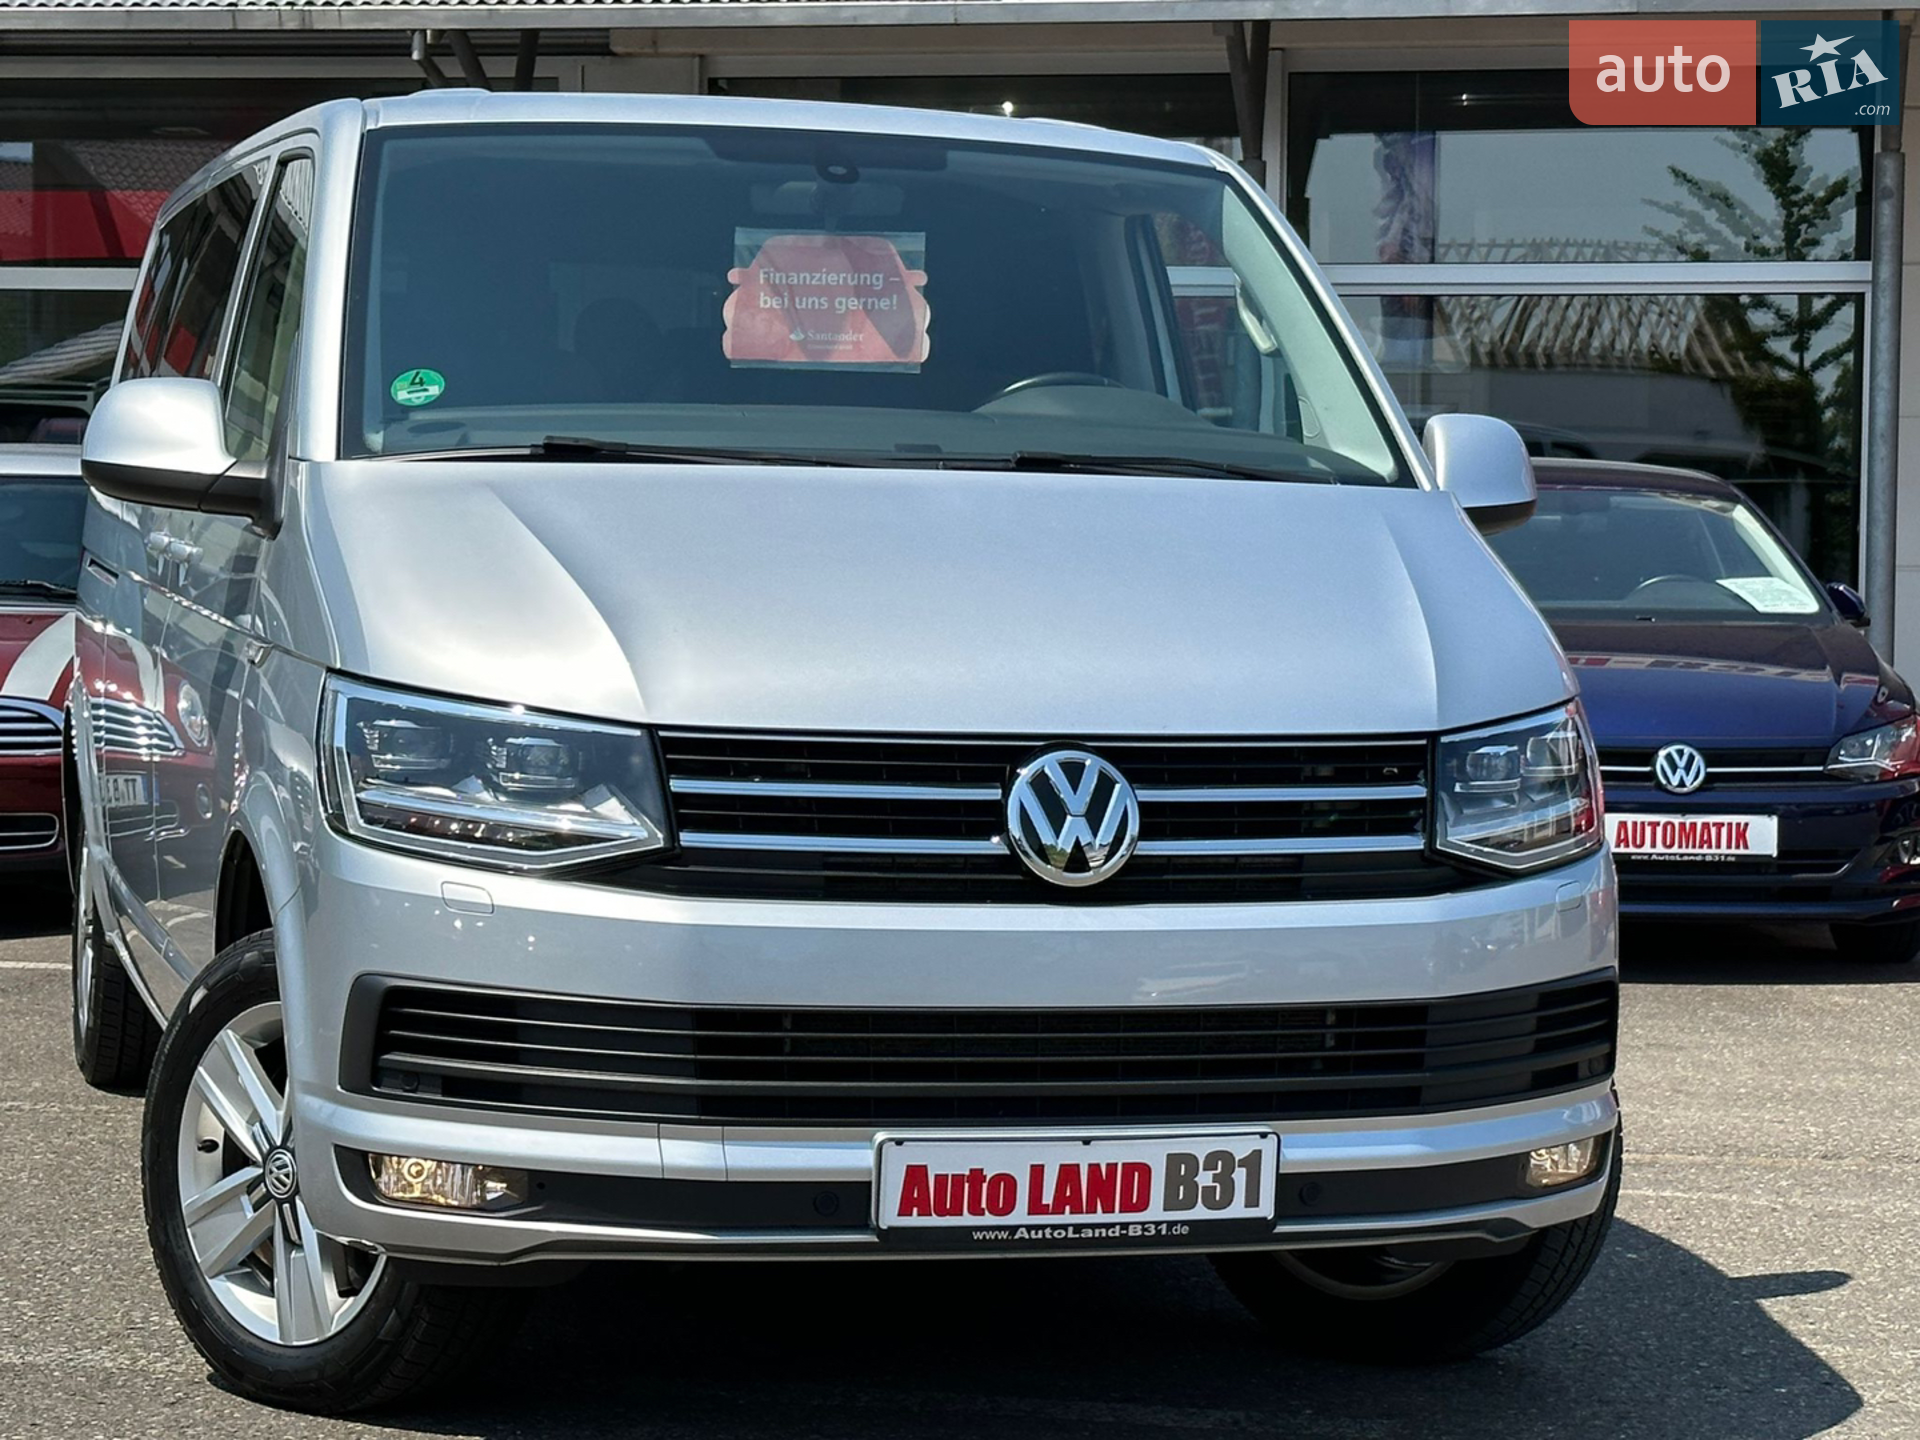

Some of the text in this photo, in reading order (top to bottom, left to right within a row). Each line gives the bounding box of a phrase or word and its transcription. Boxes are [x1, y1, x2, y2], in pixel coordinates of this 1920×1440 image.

[759, 268, 884, 289] Finanzierung
[759, 292, 898, 314] bei uns gerne!
[807, 330, 864, 342] Santander
[410, 371, 425, 387] 4
[1009, 752, 1139, 886] VW
[1614, 820, 1750, 850] AUTOMATIK
[896, 1149, 1263, 1217] Auto LAND B31
[971, 1223, 1190, 1241] www.AutoLand-B31.de
